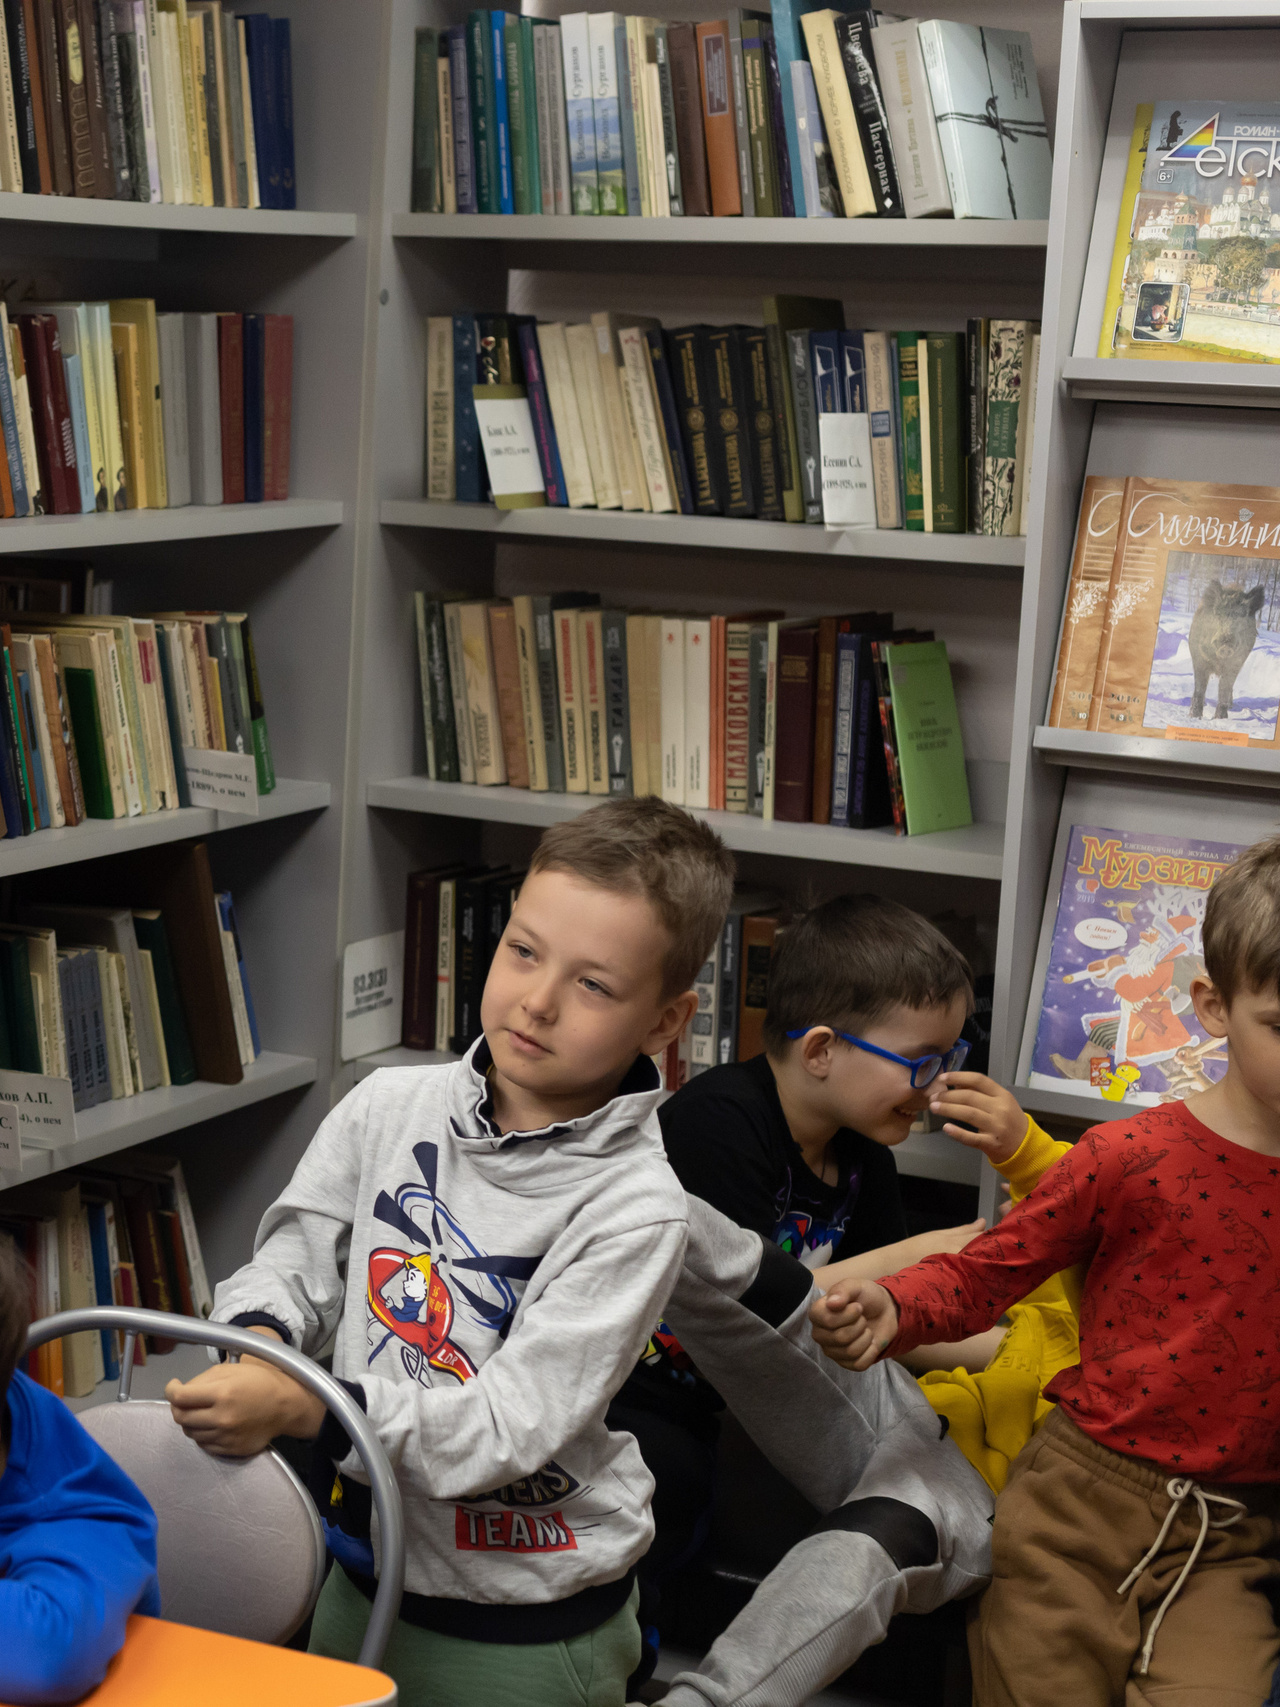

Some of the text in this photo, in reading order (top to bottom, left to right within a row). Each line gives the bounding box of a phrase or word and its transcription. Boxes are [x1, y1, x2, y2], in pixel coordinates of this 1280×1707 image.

[869, 120, 891, 195] Пастернак
[1159, 171, 1172, 182] 6+
[1077, 835, 1232, 891] Мурзил
[23, 1091, 53, 1105] А.П.
[437, 1348, 459, 1367] LDR
[462, 1507, 569, 1549] TEAM
